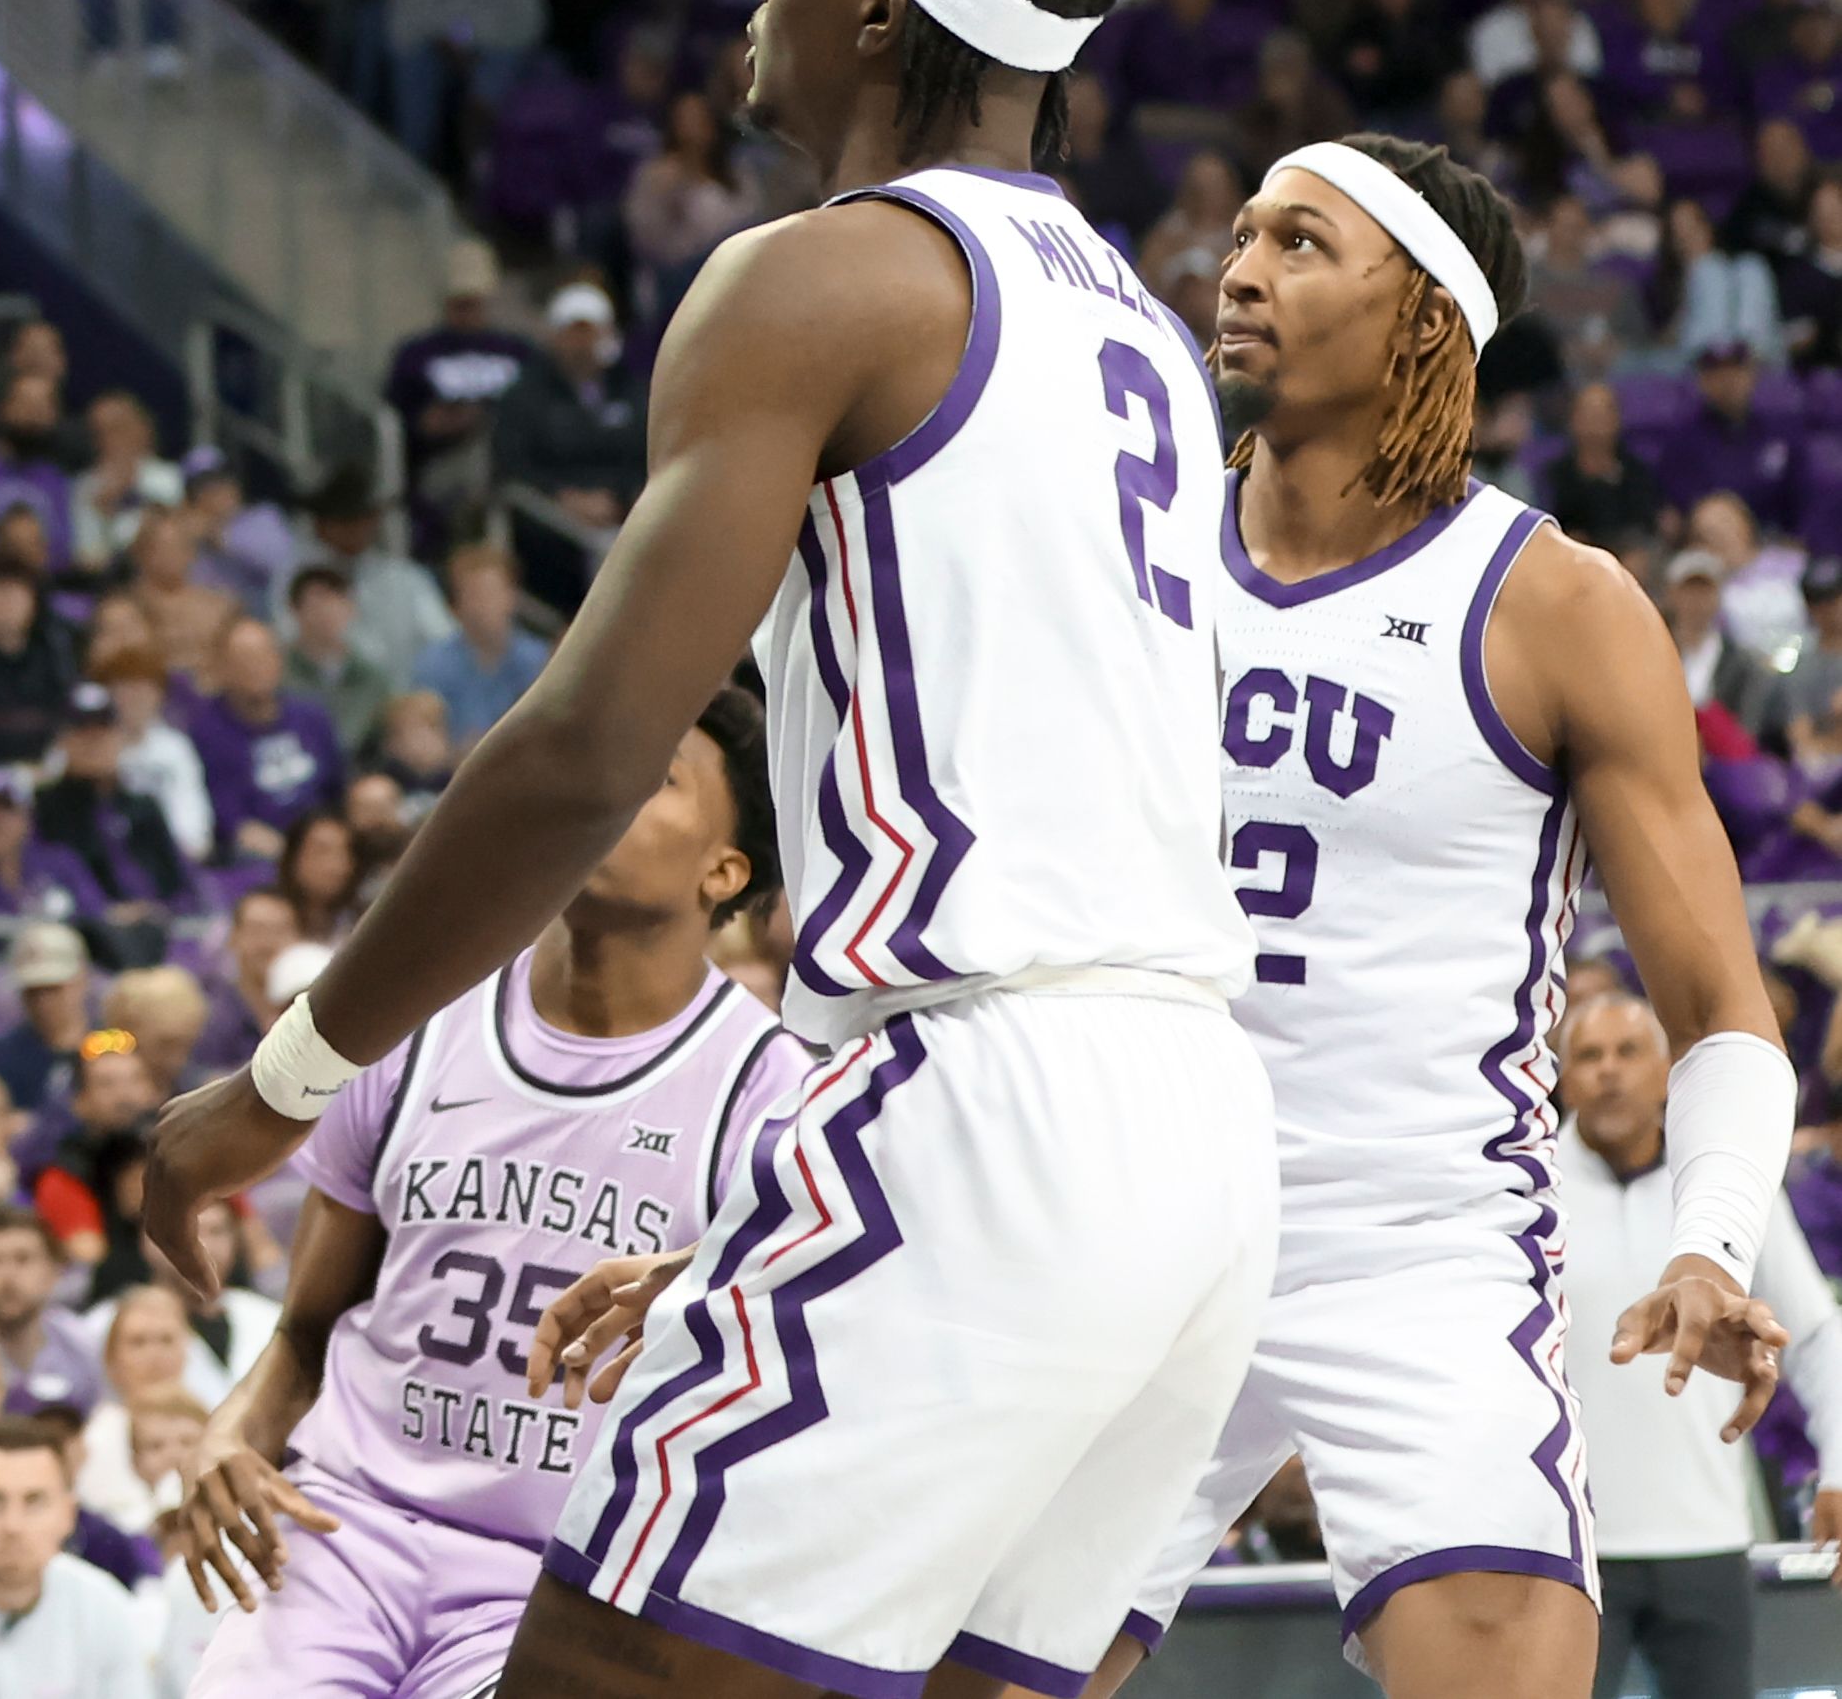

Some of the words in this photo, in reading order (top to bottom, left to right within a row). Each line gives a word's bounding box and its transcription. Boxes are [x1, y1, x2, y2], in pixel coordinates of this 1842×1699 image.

[1098, 337, 1194, 630] 2
[1218, 667, 1395, 799] CU
[401, 1158, 669, 1256] KANSAS
[417, 1250, 585, 1384] 35
[403, 1381, 580, 1474] STATE
